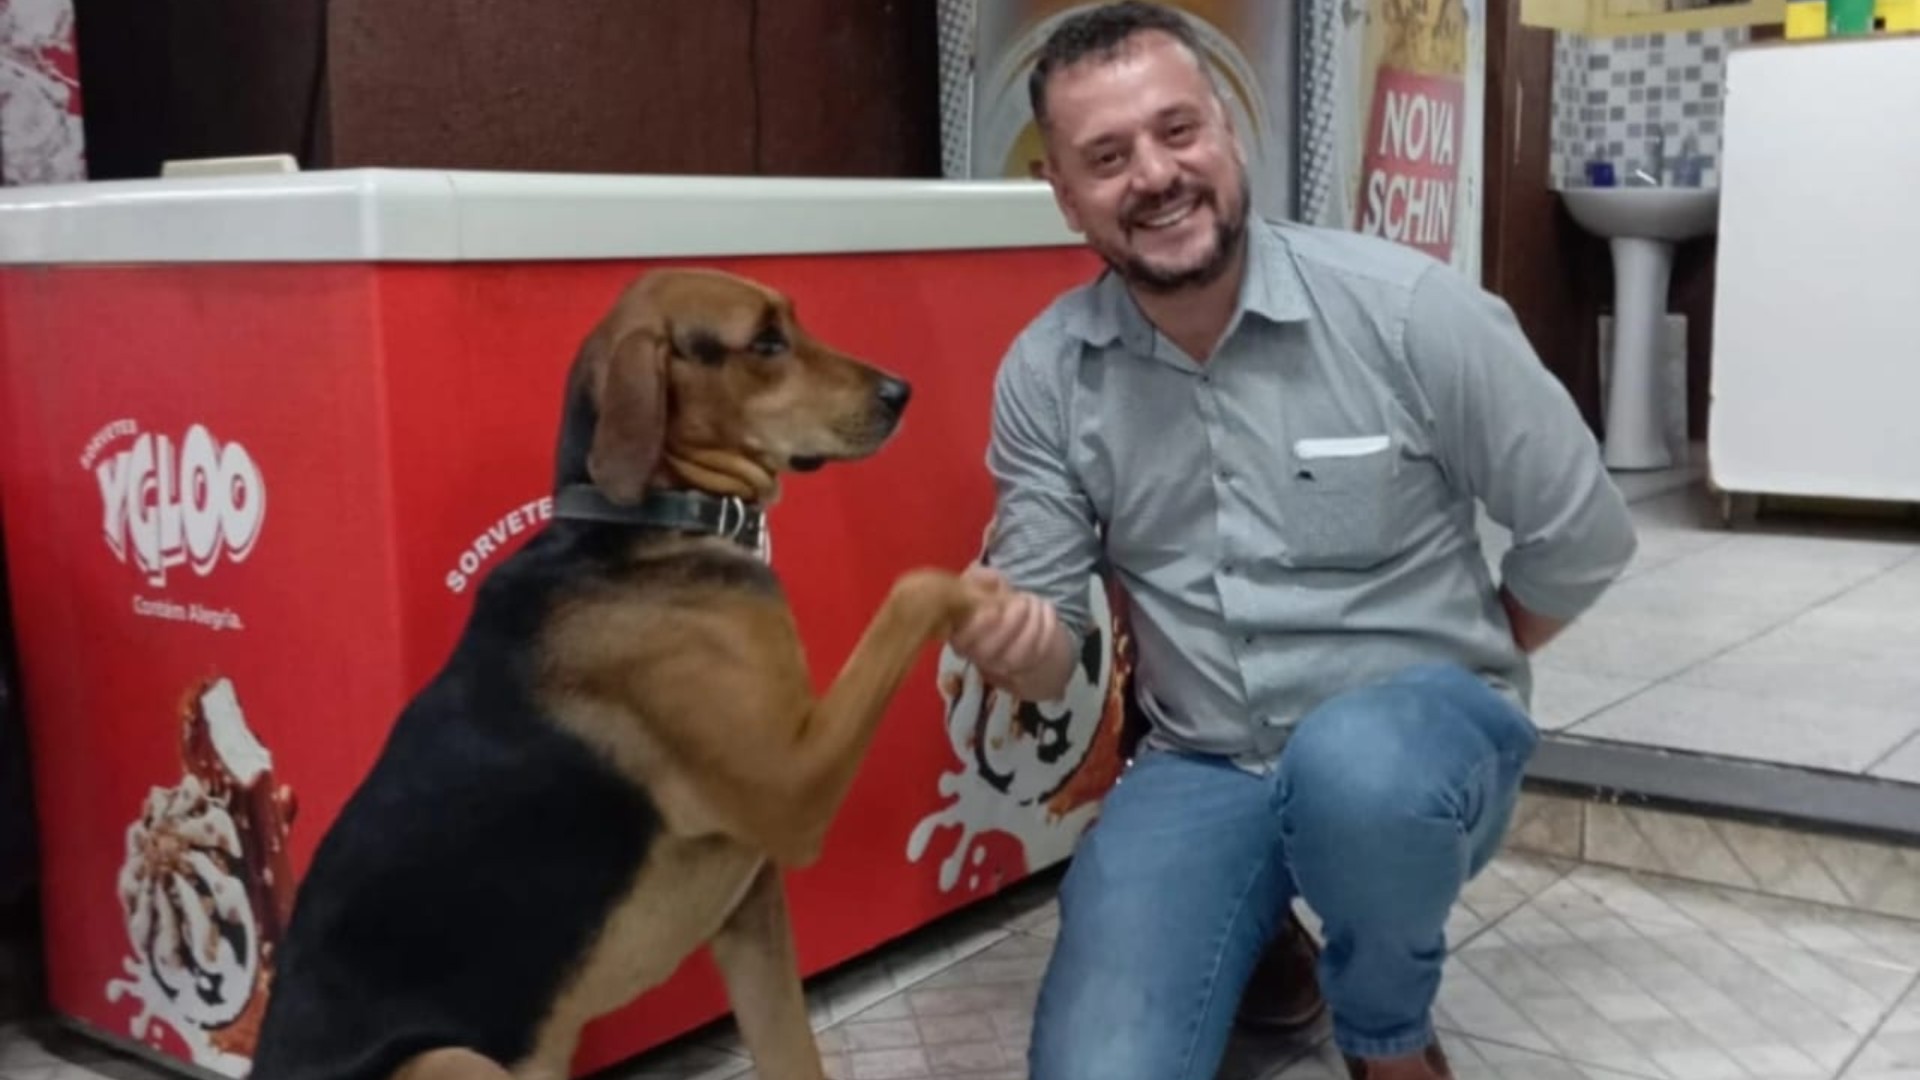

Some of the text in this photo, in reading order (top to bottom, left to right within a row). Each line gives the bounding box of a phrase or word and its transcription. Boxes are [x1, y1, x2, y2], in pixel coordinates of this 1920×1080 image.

[1379, 89, 1454, 165] NOVA
[1363, 168, 1453, 244] SCHIN
[96, 423, 266, 588] YGLOO
